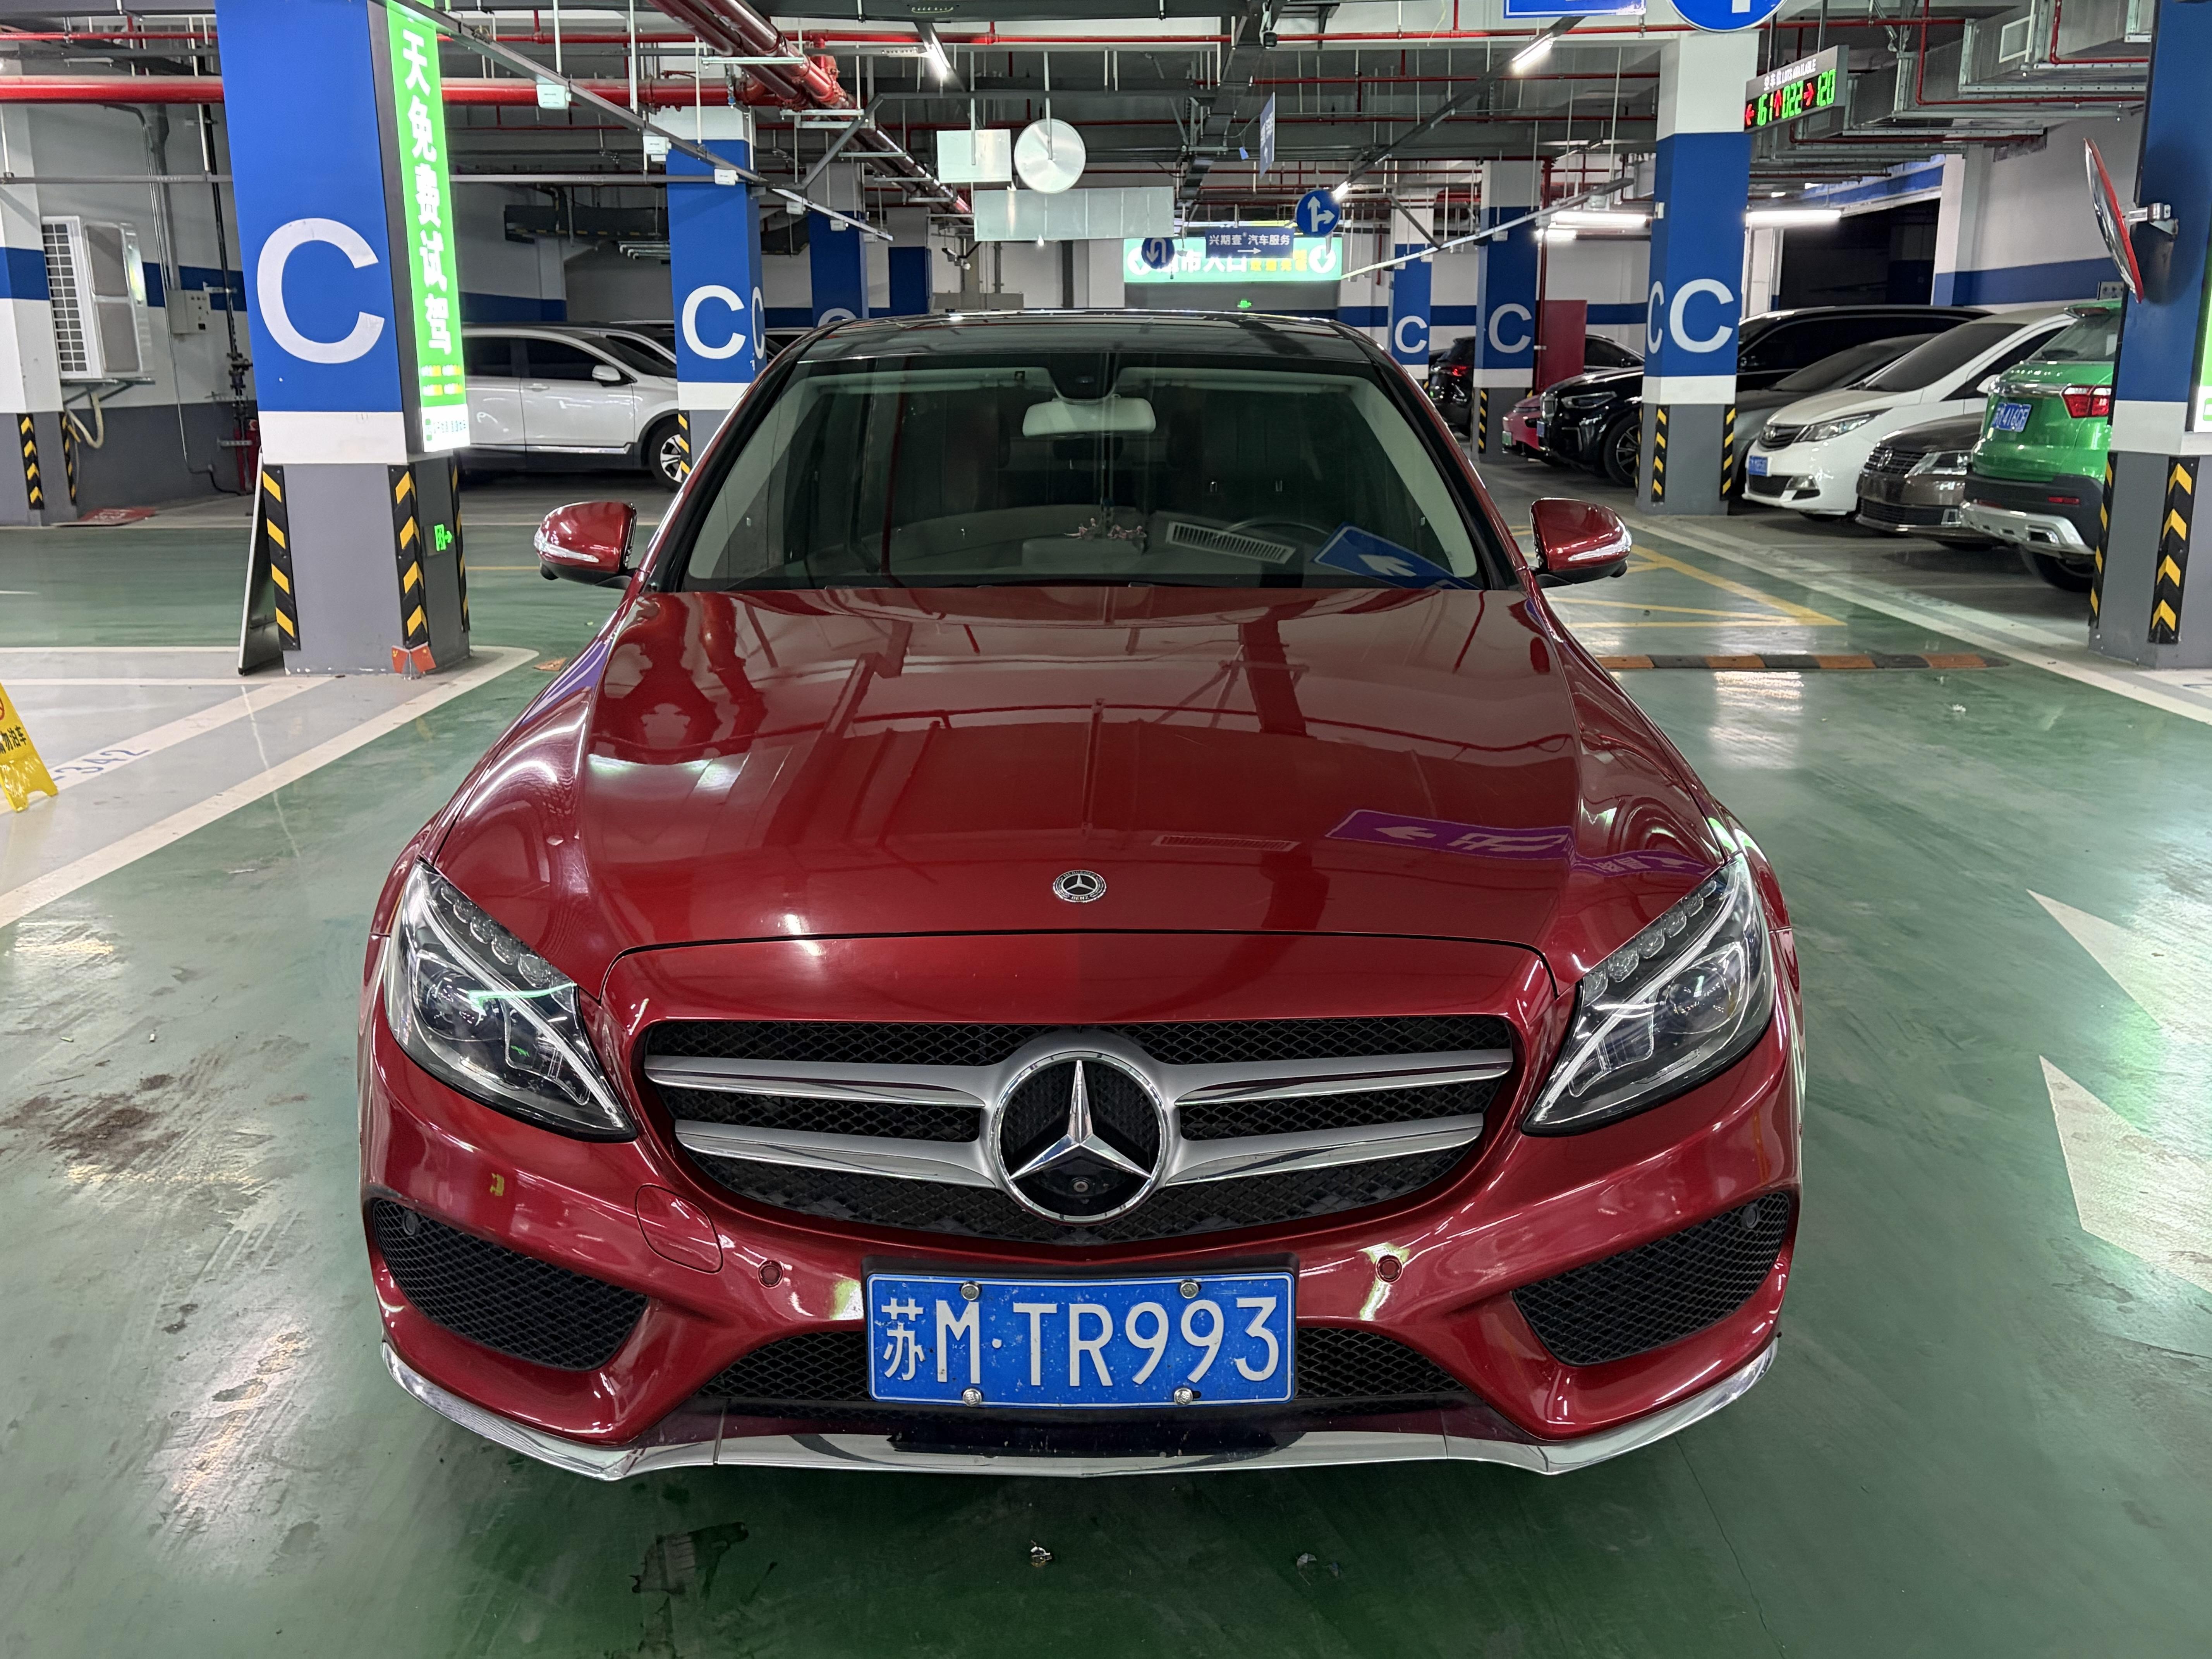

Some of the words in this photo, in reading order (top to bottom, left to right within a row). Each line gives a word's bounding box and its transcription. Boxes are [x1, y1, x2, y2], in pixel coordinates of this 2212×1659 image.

[1757, 93, 1774, 126] 161
[1782, 80, 1803, 119] 022
[1817, 69, 1837, 107] 120
[1158, 249, 1247, 273] 市入口
[1248, 234, 1290, 246] 汽车服务
[257, 218, 385, 364] C
[682, 285, 746, 360] C
[752, 287, 765, 359] C
[1647, 281, 1665, 354] C
[1669, 278, 1735, 353] C
[1395, 316, 1427, 353] C
[1489, 303, 1532, 354] C
